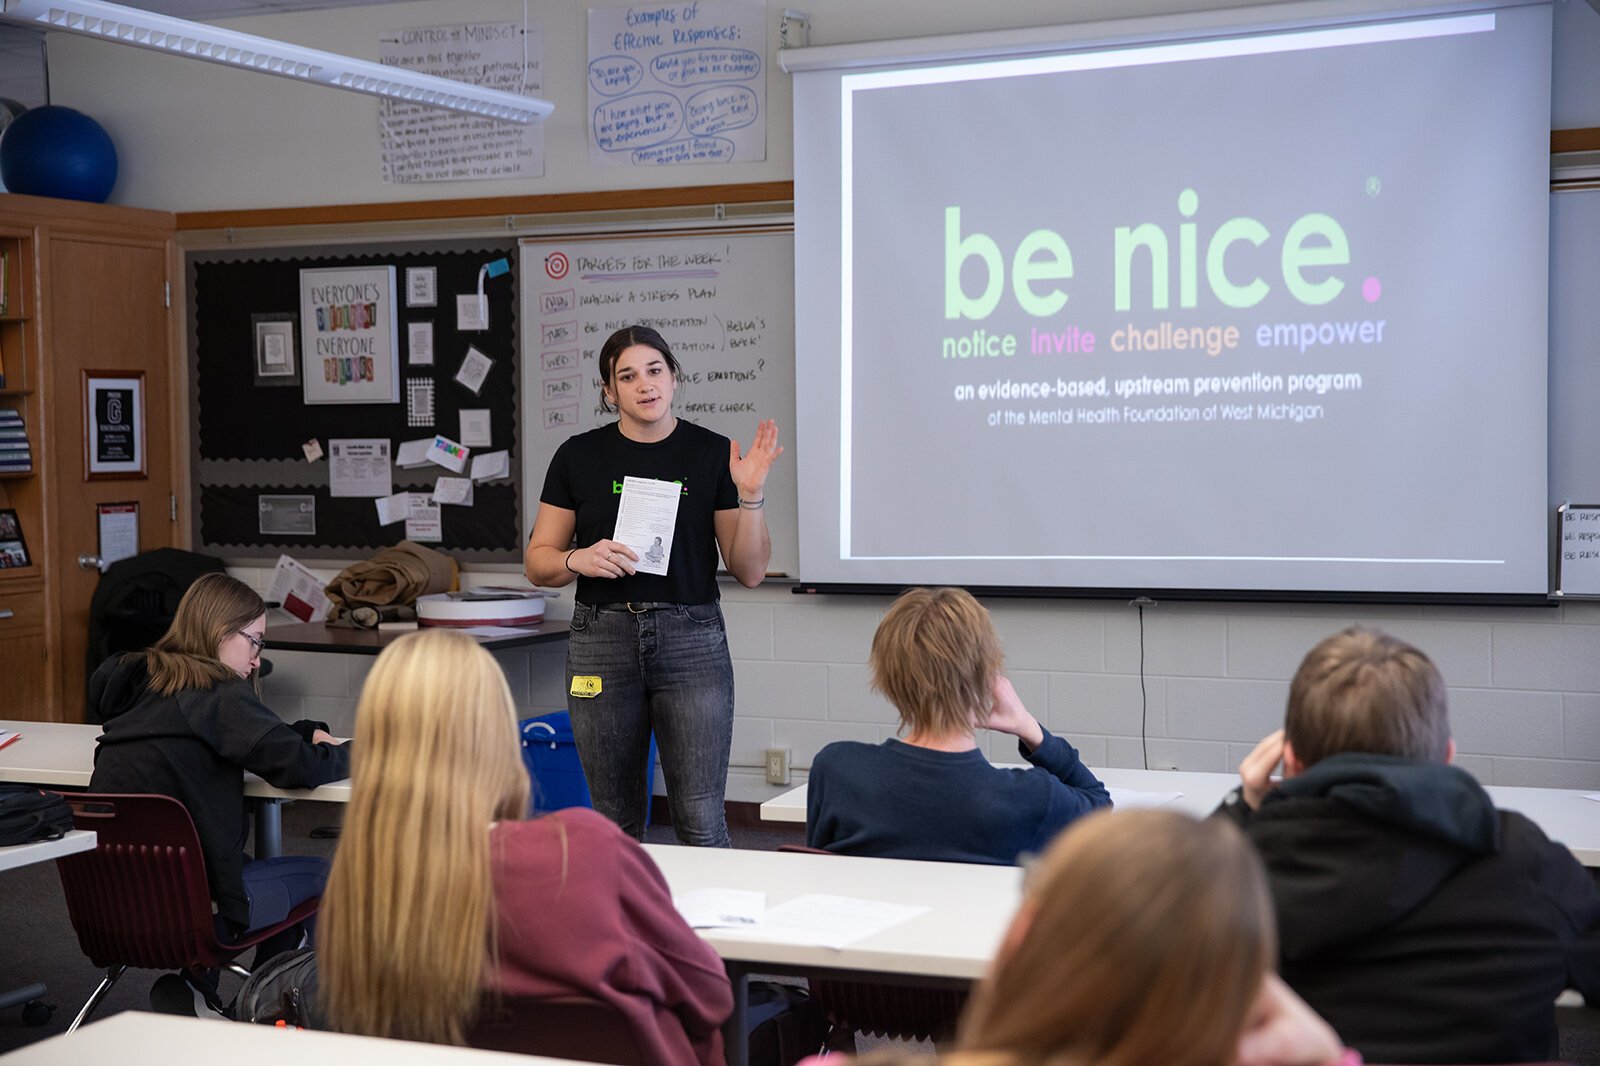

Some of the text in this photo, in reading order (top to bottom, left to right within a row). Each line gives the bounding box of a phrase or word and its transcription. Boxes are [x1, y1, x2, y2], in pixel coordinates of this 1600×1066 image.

[465, 24, 518, 42] MINDSET
[658, 253, 680, 267] THE
[945, 187, 1382, 321] be nice.
[311, 283, 381, 304] EVERYONE'S
[688, 286, 717, 301] PLAN
[317, 337, 376, 356] EVERYONE
[942, 317, 1386, 359] notice invite challenge empower
[954, 372, 1362, 401] an evidence-based, upstream prevention program
[685, 401, 756, 413] GRADE CHECK
[988, 402, 1324, 426] of the Mental Health Foundation of West Michigan
